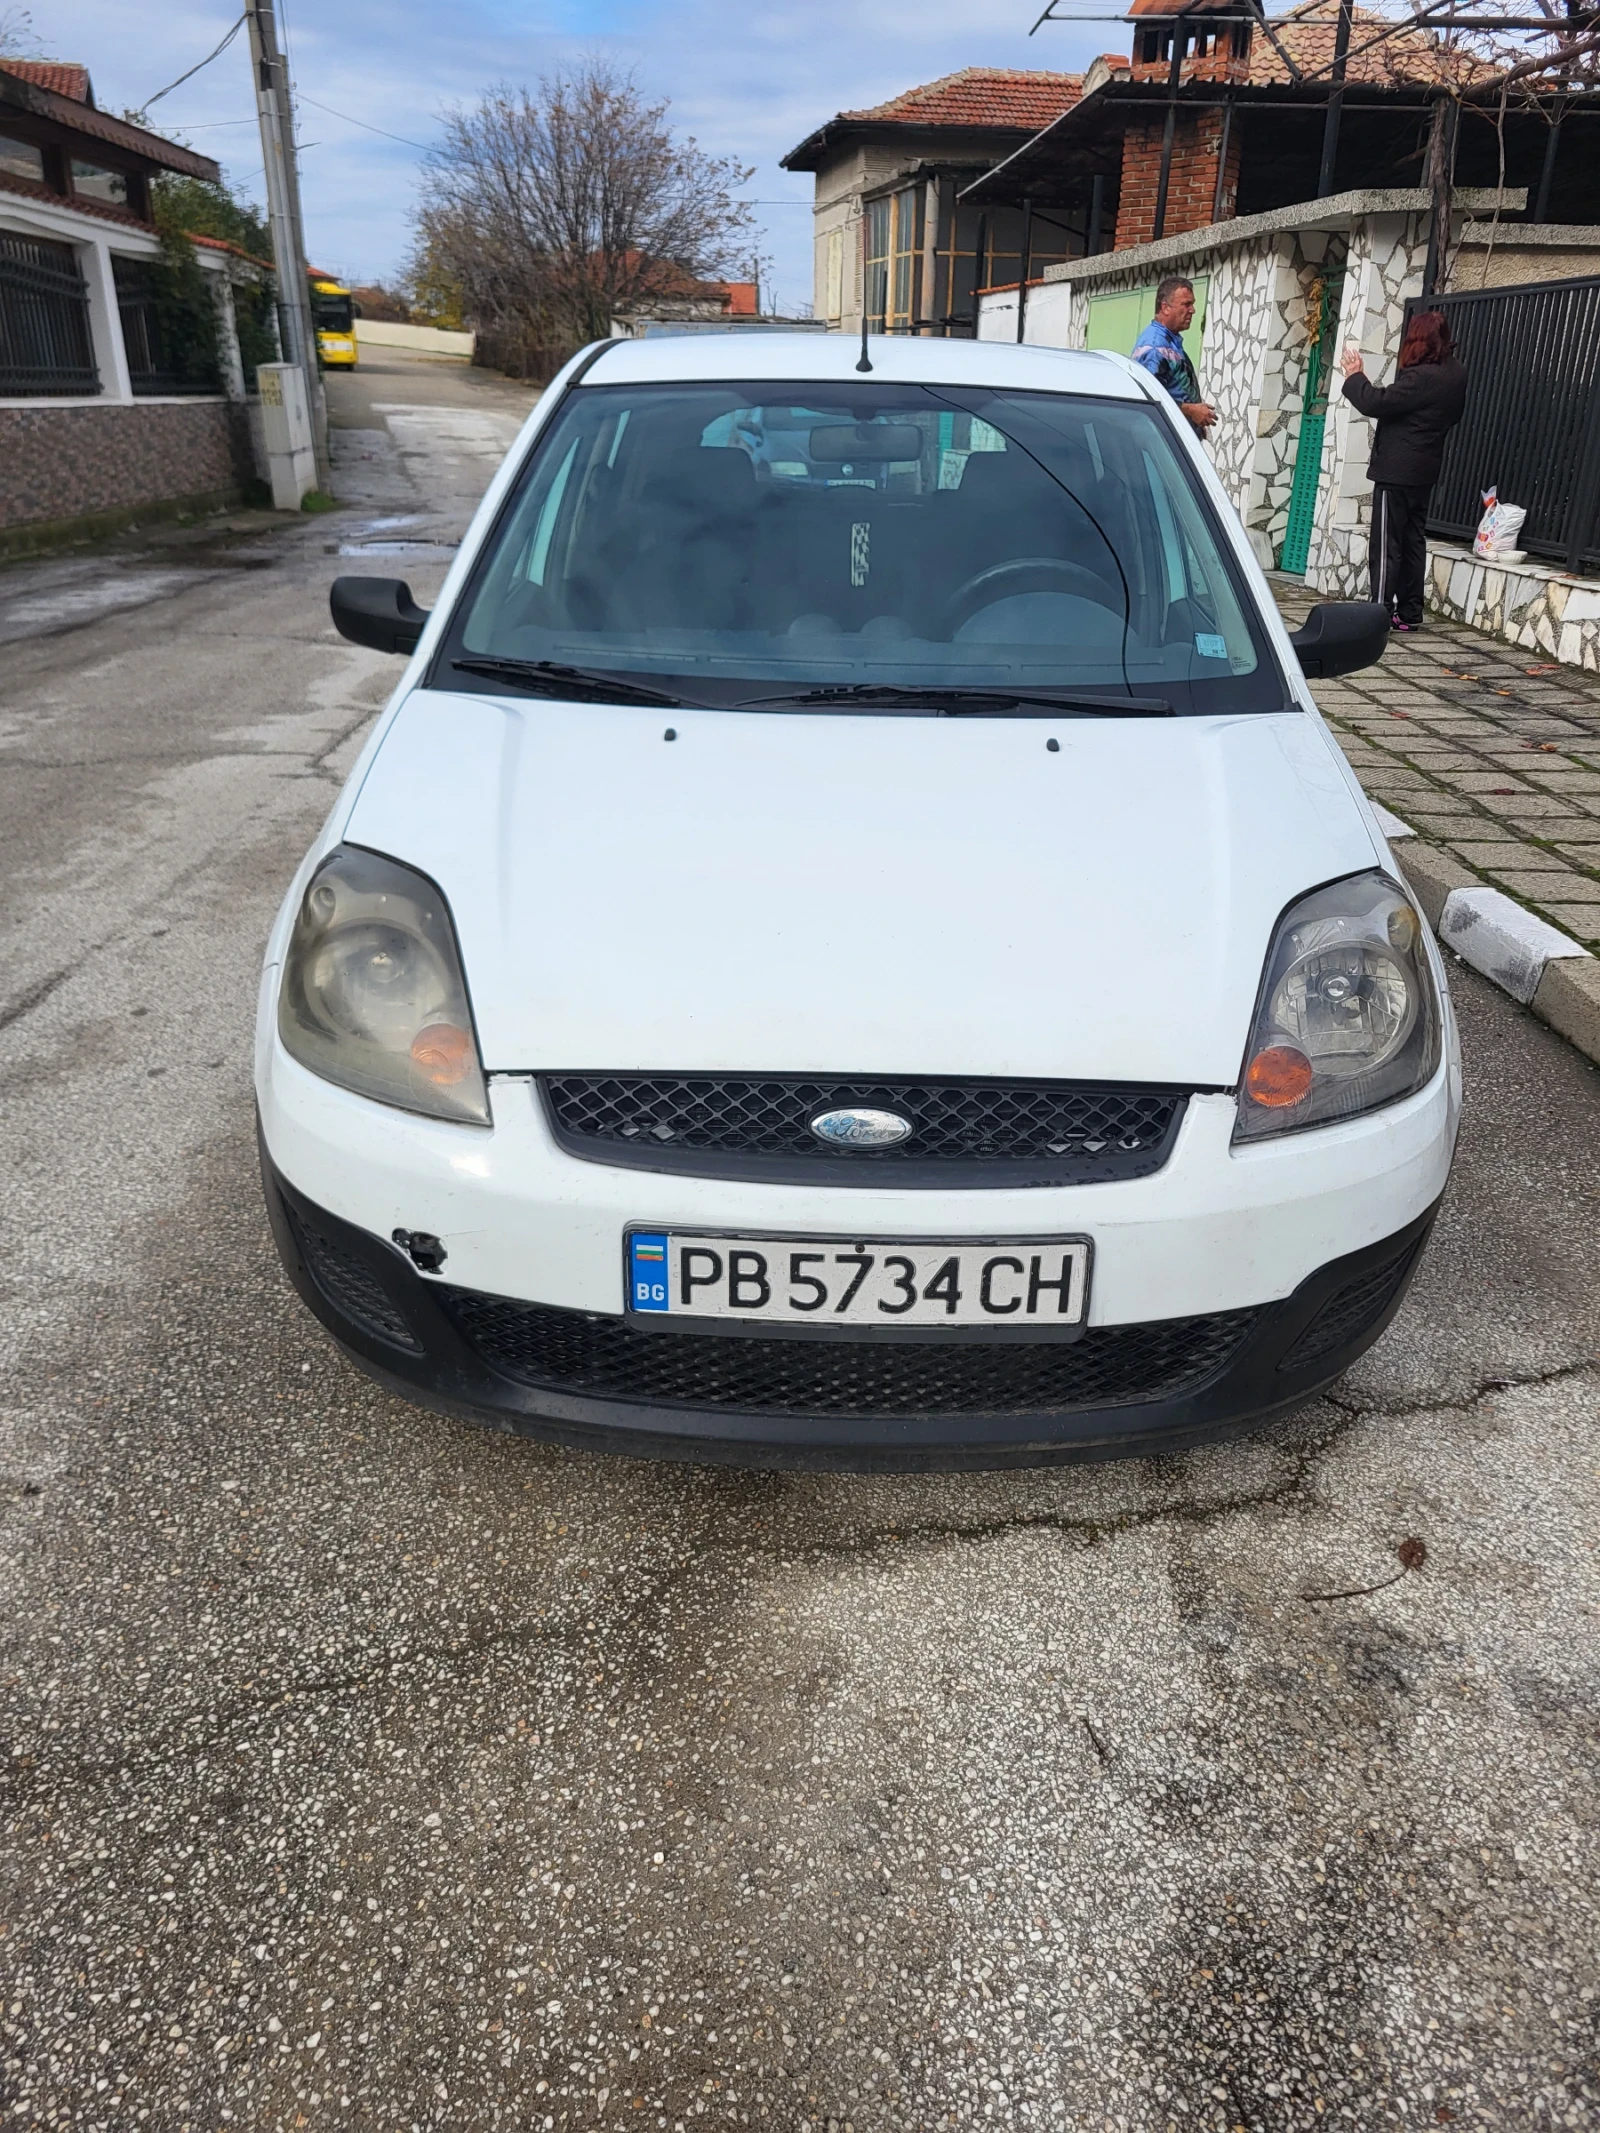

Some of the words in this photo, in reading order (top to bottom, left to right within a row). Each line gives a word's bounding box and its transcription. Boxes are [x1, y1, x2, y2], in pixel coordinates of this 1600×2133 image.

[834, 1116, 890, 1138] Ford
[636, 1282, 665, 1301] BG
[680, 1246, 771, 1308] PB
[789, 1253, 963, 1315] 5734
[979, 1254, 1074, 1314] CH
